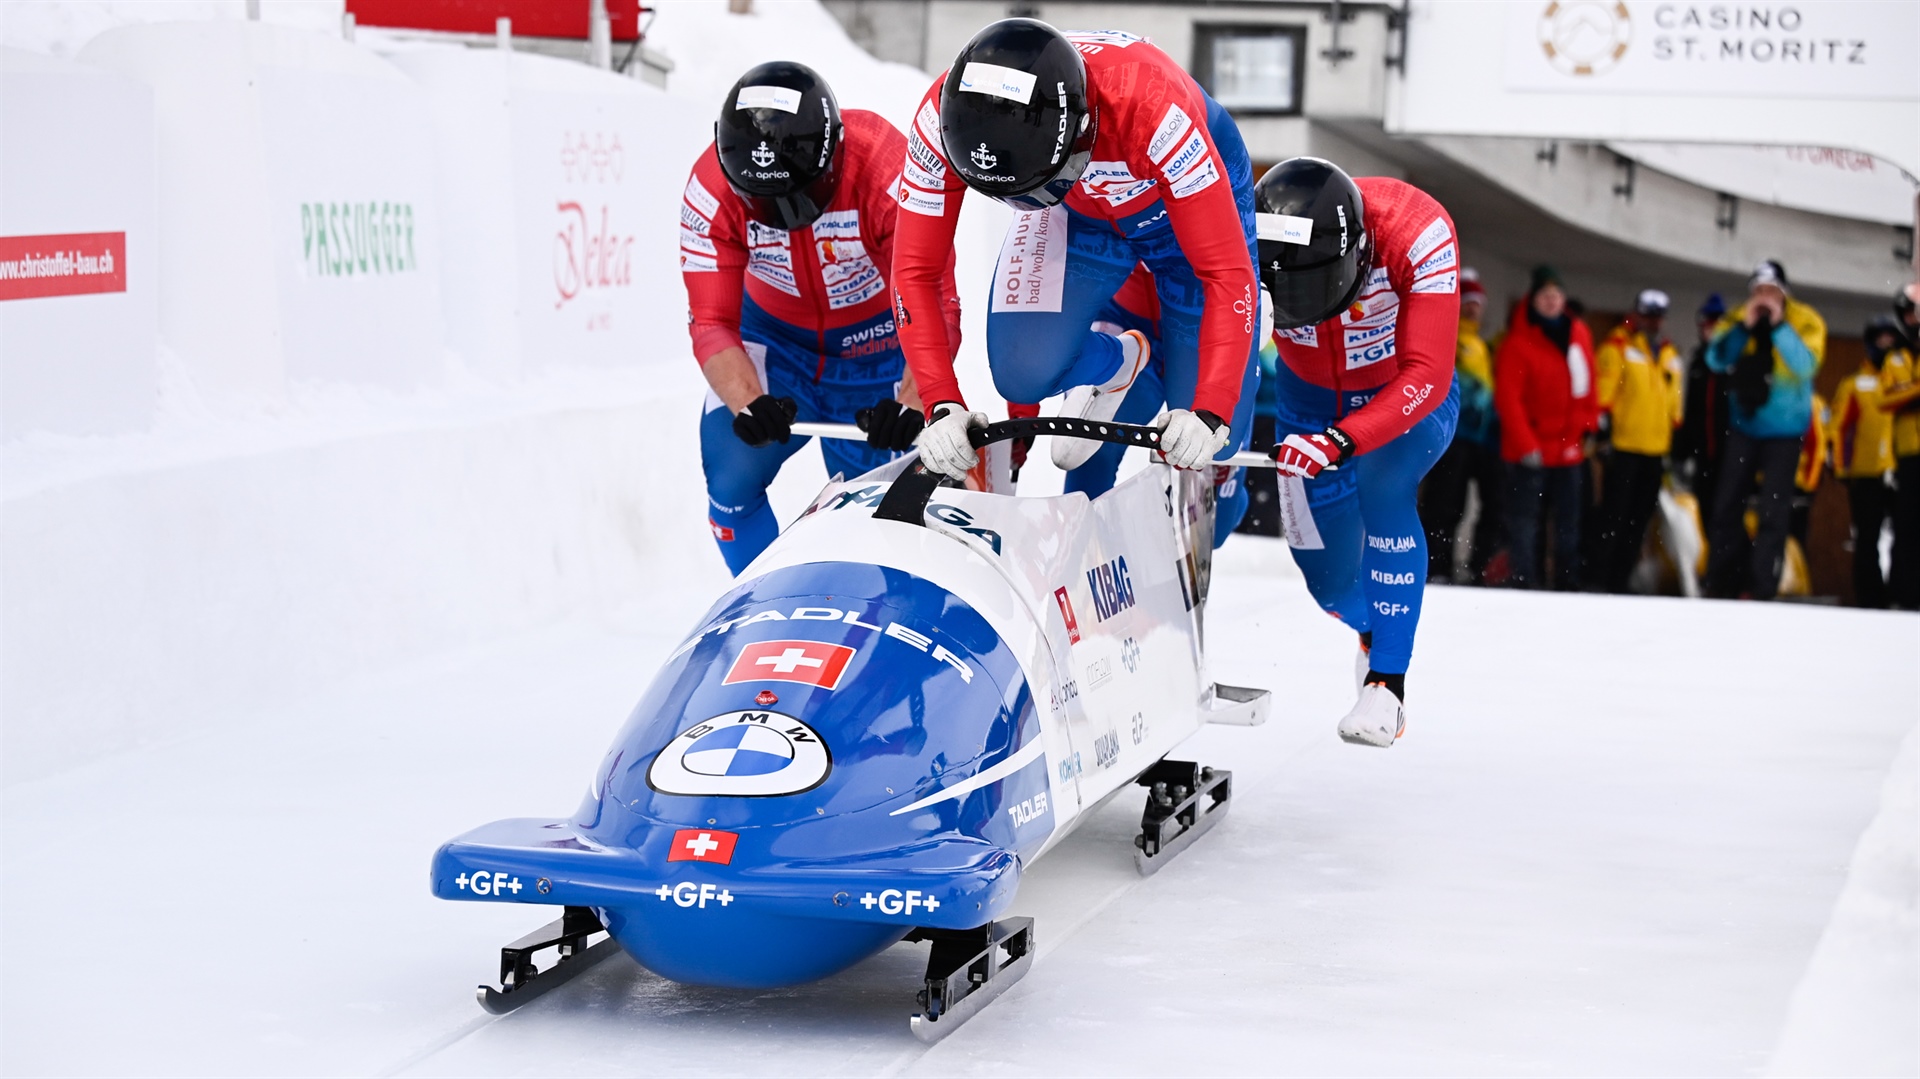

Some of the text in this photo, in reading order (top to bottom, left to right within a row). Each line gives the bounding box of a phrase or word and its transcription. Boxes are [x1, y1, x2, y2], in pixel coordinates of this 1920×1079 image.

[1654, 7, 1803, 31] CASINO
[1653, 37, 1867, 65] ST. MORITZ
[1002, 83, 1021, 94] tech
[818, 97, 832, 168] STADLER
[1051, 81, 1068, 165] STADLER
[971, 151, 997, 162] KIBAG
[1167, 138, 1201, 174] KOHLER
[756, 170, 789, 180] aprica
[977, 173, 1015, 182] aprica
[1082, 170, 1131, 181] TADLER
[301, 202, 417, 277] PASSUGGER
[1284, 229, 1301, 238] tech
[1418, 249, 1452, 272] KOHLER
[830, 268, 876, 294] KIBAG
[832, 282, 882, 304] +GF+
[1244, 283, 1253, 334] OMEGA
[842, 320, 895, 347] SWISS
[1402, 382, 1434, 416] OMEGA
[1368, 535, 1417, 551] SILVAPLANA
[1086, 555, 1136, 623] KIBAG
[1371, 569, 1415, 585] KIBAG
[1373, 601, 1409, 617] +GF+
[666, 607, 974, 685] STADLER
[684, 712, 817, 745] BMW
[1008, 791, 1049, 829] TADLER
[455, 870, 523, 896] +GF+
[655, 881, 735, 909] +GF+
[860, 889, 941, 916] +GF+
